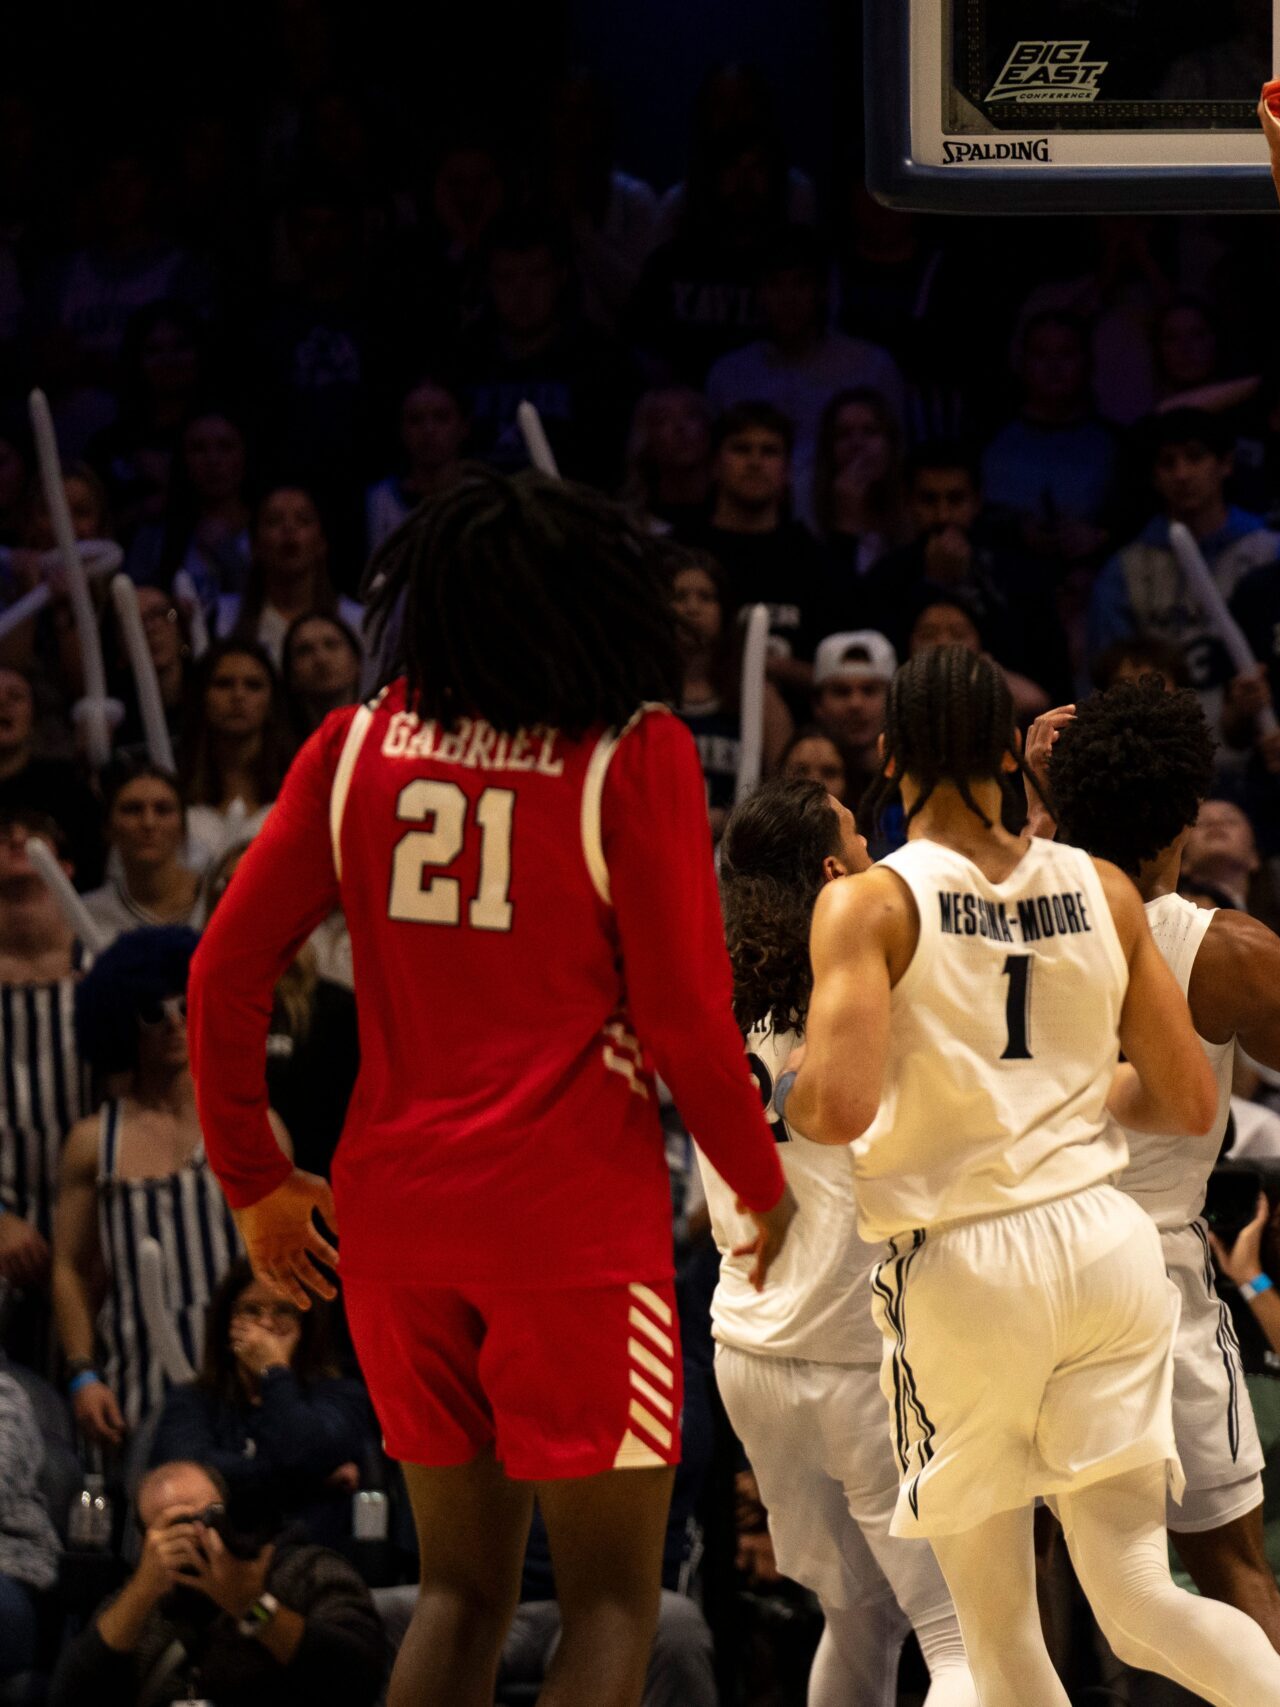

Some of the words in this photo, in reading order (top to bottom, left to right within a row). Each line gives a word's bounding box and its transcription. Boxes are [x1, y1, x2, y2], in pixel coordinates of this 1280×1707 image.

[1009, 43, 1084, 65] BIG
[999, 65, 1102, 85] EAST
[1019, 91, 1093, 100] CONFERENCE
[942, 138, 1050, 165] SPALDING
[381, 709, 565, 778] GABRIEL
[387, 777, 516, 932] 21
[999, 953, 1036, 1061] 1
